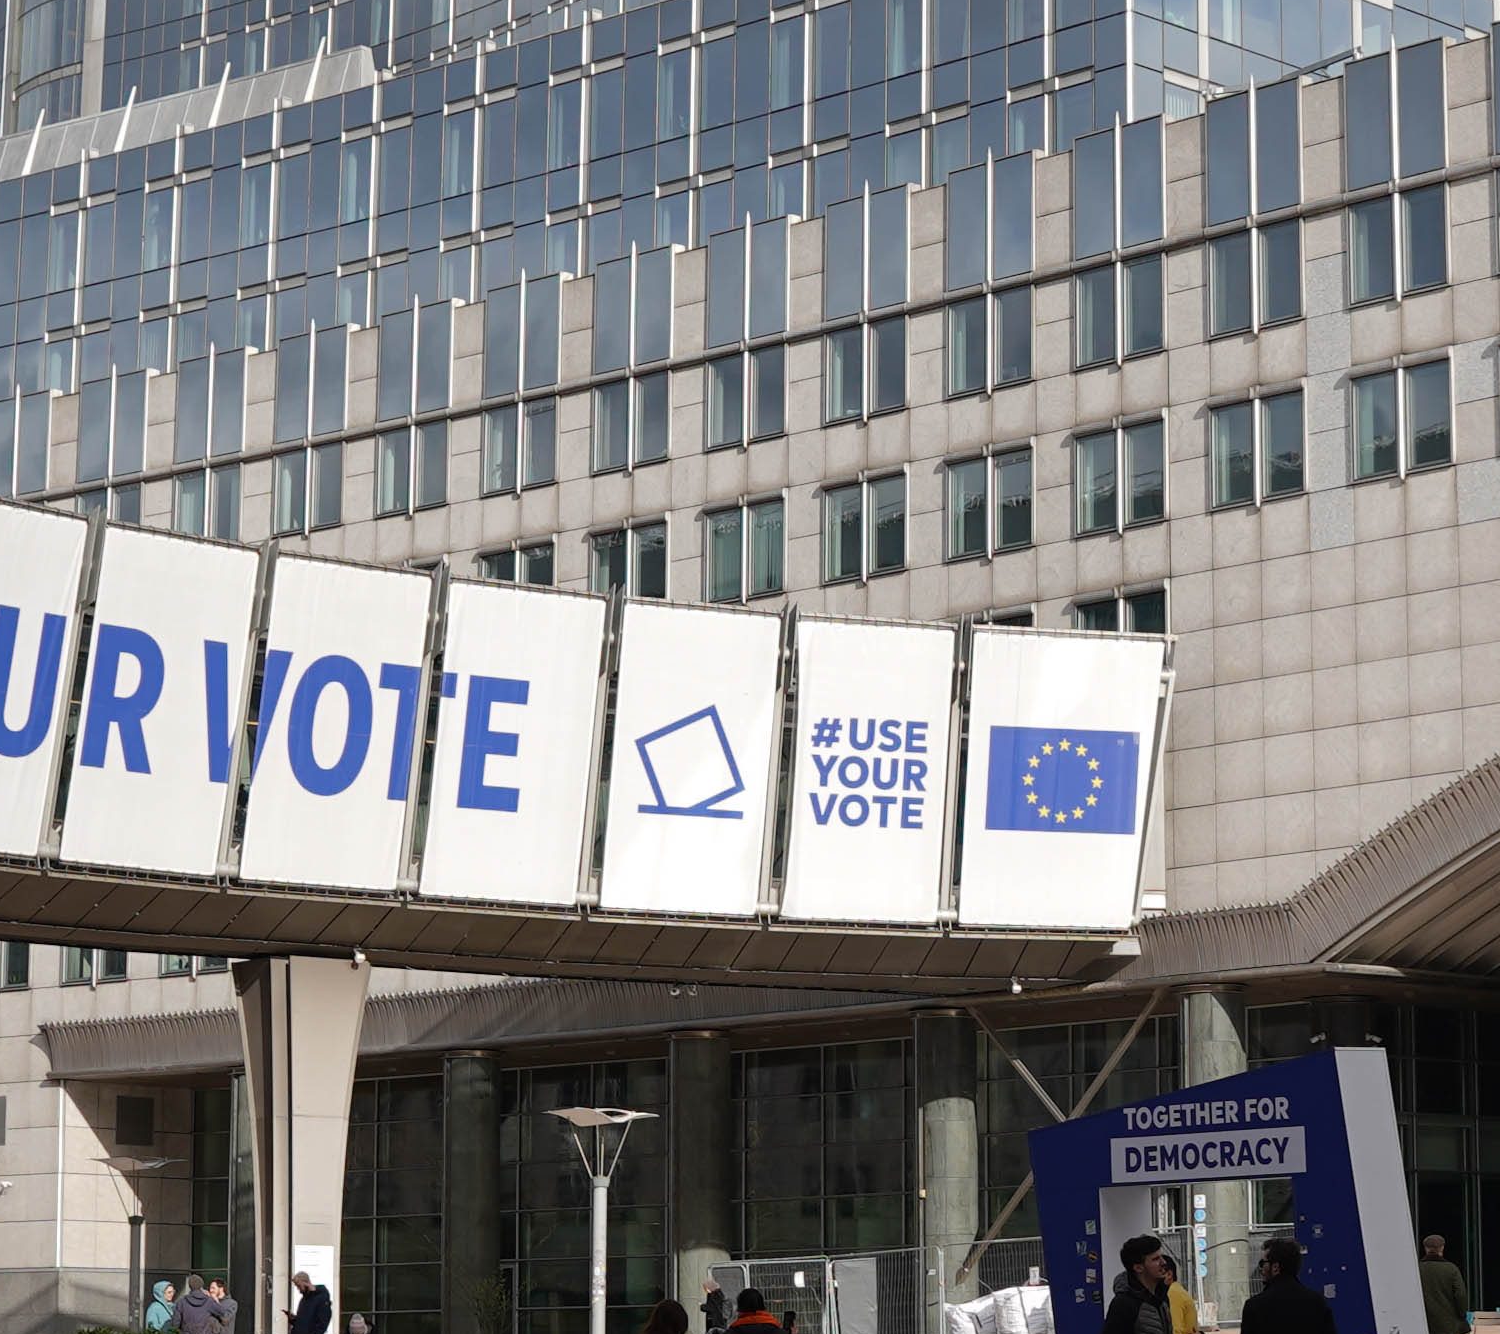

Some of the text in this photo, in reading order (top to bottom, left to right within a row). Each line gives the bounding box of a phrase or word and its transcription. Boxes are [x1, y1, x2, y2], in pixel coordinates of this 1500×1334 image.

[203, 640, 530, 813] VOTE
[813, 753, 927, 792] YOUR
[808, 793, 925, 830] VOTE
[1123, 1097, 1289, 1131] TOGETHER FOR
[1125, 1136, 1289, 1173] DEMOCRACY
